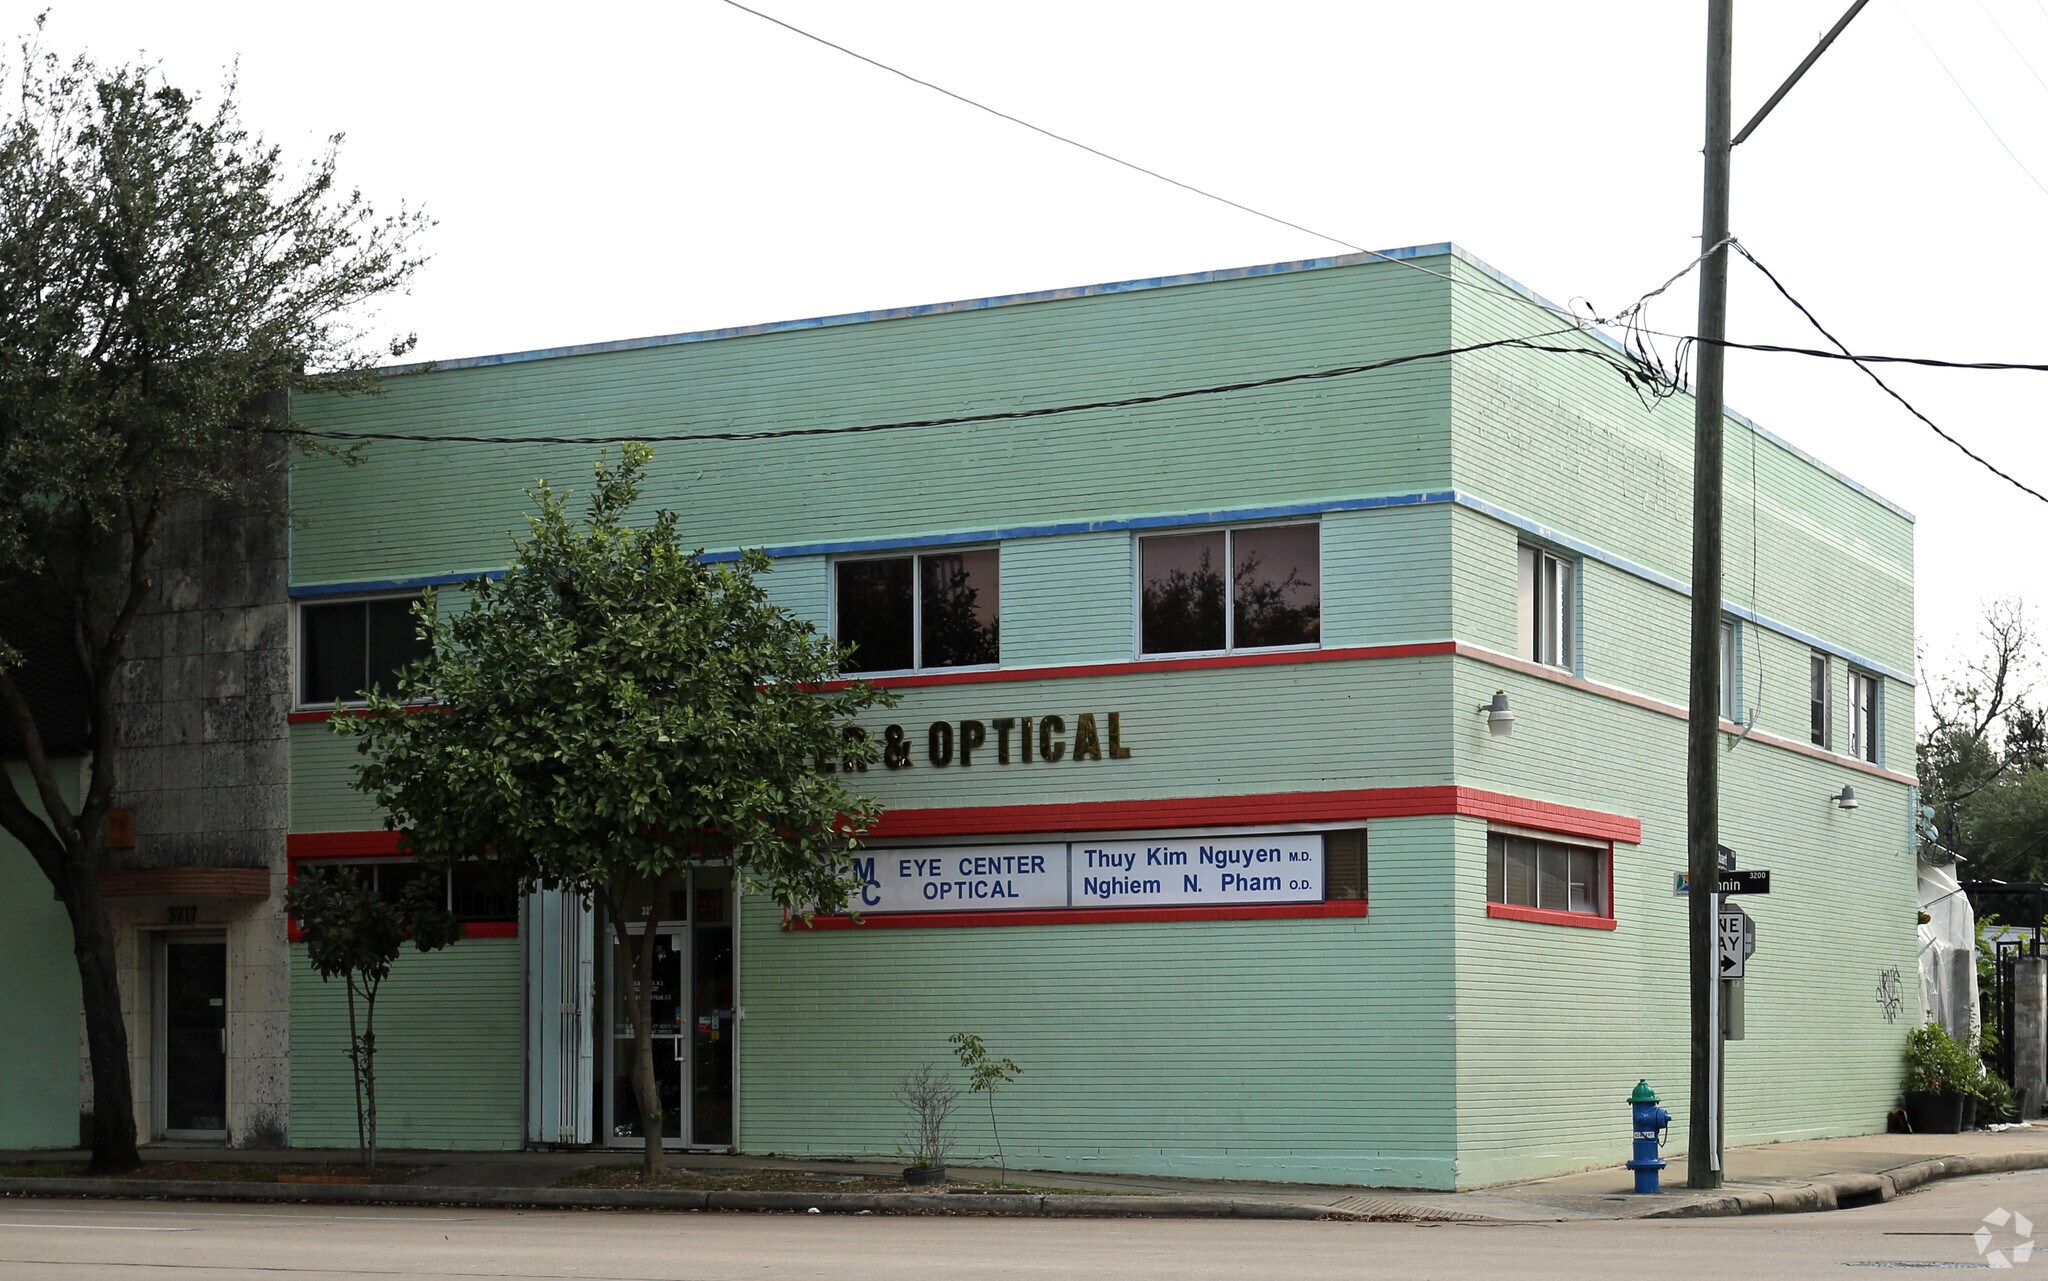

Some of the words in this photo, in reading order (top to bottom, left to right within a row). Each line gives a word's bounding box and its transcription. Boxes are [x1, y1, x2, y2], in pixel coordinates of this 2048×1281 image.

[884, 723, 913, 771] &
[928, 711, 1132, 768] OPTICAL
[899, 858, 942, 877] EYE
[958, 855, 1046, 876] CENTER
[1083, 849, 1136, 872] Thuy
[1147, 846, 1188, 866] Kim
[1199, 845, 1281, 869] Nguyen
[1289, 851, 1312, 862] M.D.
[850, 857, 876, 883] M
[861, 880, 882, 906] C
[922, 880, 1020, 900] OPTICAL
[1084, 876, 1161, 899] Nghiem
[1183, 874, 1202, 893] N.
[1221, 873, 1281, 892] Pham
[1289, 879, 1312, 890] O.D.
[1718, 878, 1741, 891] nnin
[167, 905, 198, 922] 3217
[1719, 917, 1740, 933] NE
[1719, 936, 1741, 951] AY
